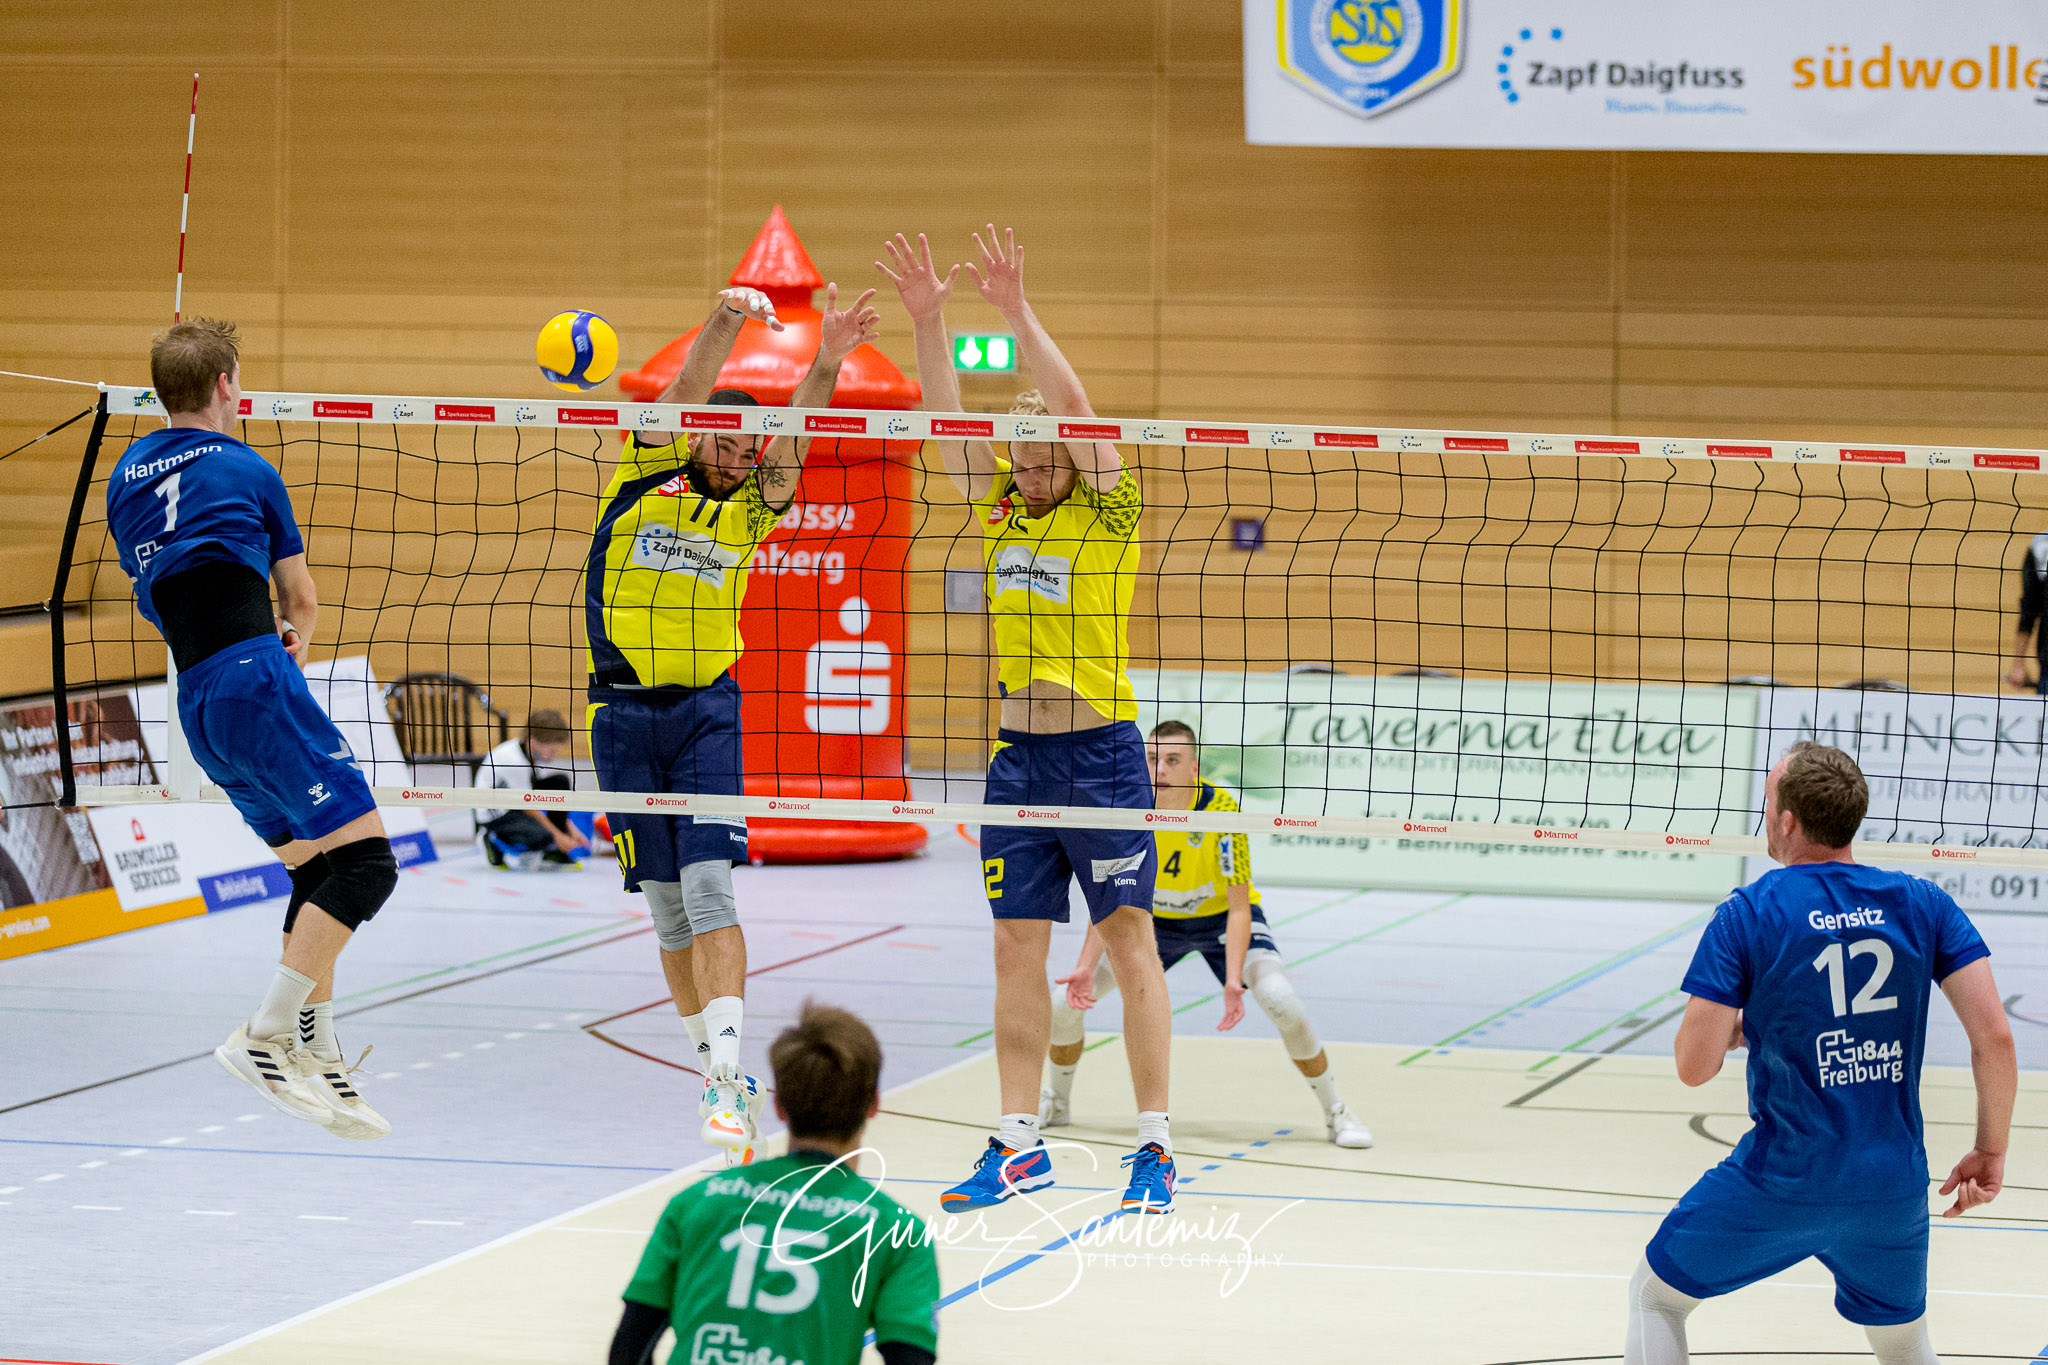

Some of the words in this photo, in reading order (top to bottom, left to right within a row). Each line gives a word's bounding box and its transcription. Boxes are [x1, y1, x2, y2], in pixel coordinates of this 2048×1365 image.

[1528, 60, 1600, 91] Zapf
[1607, 61, 1744, 92] Daigfuss
[124, 445, 222, 483] Hartmann
[154, 472, 182, 532] 1
[653, 541, 682, 557] Zapf
[1275, 702, 1557, 752] Taverna
[1574, 706, 1720, 757] Elia
[412, 791, 443, 799] Marmot
[533, 794, 565, 802] Marmot
[655, 798, 688, 806] Marmot
[778, 802, 810, 810] Marmot
[1027, 810, 1060, 818] Marmot
[1154, 814, 1188, 822] Marmot
[1284, 819, 1318, 827] Marmot
[1413, 824, 1447, 832] Marmot
[1544, 830, 1578, 839] Marmot
[729, 831, 748, 845] Kemp
[1676, 837, 1710, 845] Marmot
[612, 828, 636, 869] 11
[1942, 850, 1976, 858] Marmot
[1162, 850, 1182, 878] 4
[981, 857, 1005, 900] 2
[1807, 906, 1886, 931] Gensitz
[1812, 938, 1899, 1019] 12
[1856, 1039, 1904, 1062] 1844
[1819, 1060, 1904, 1088] Freiburg
[719, 1223, 830, 1315] 15
